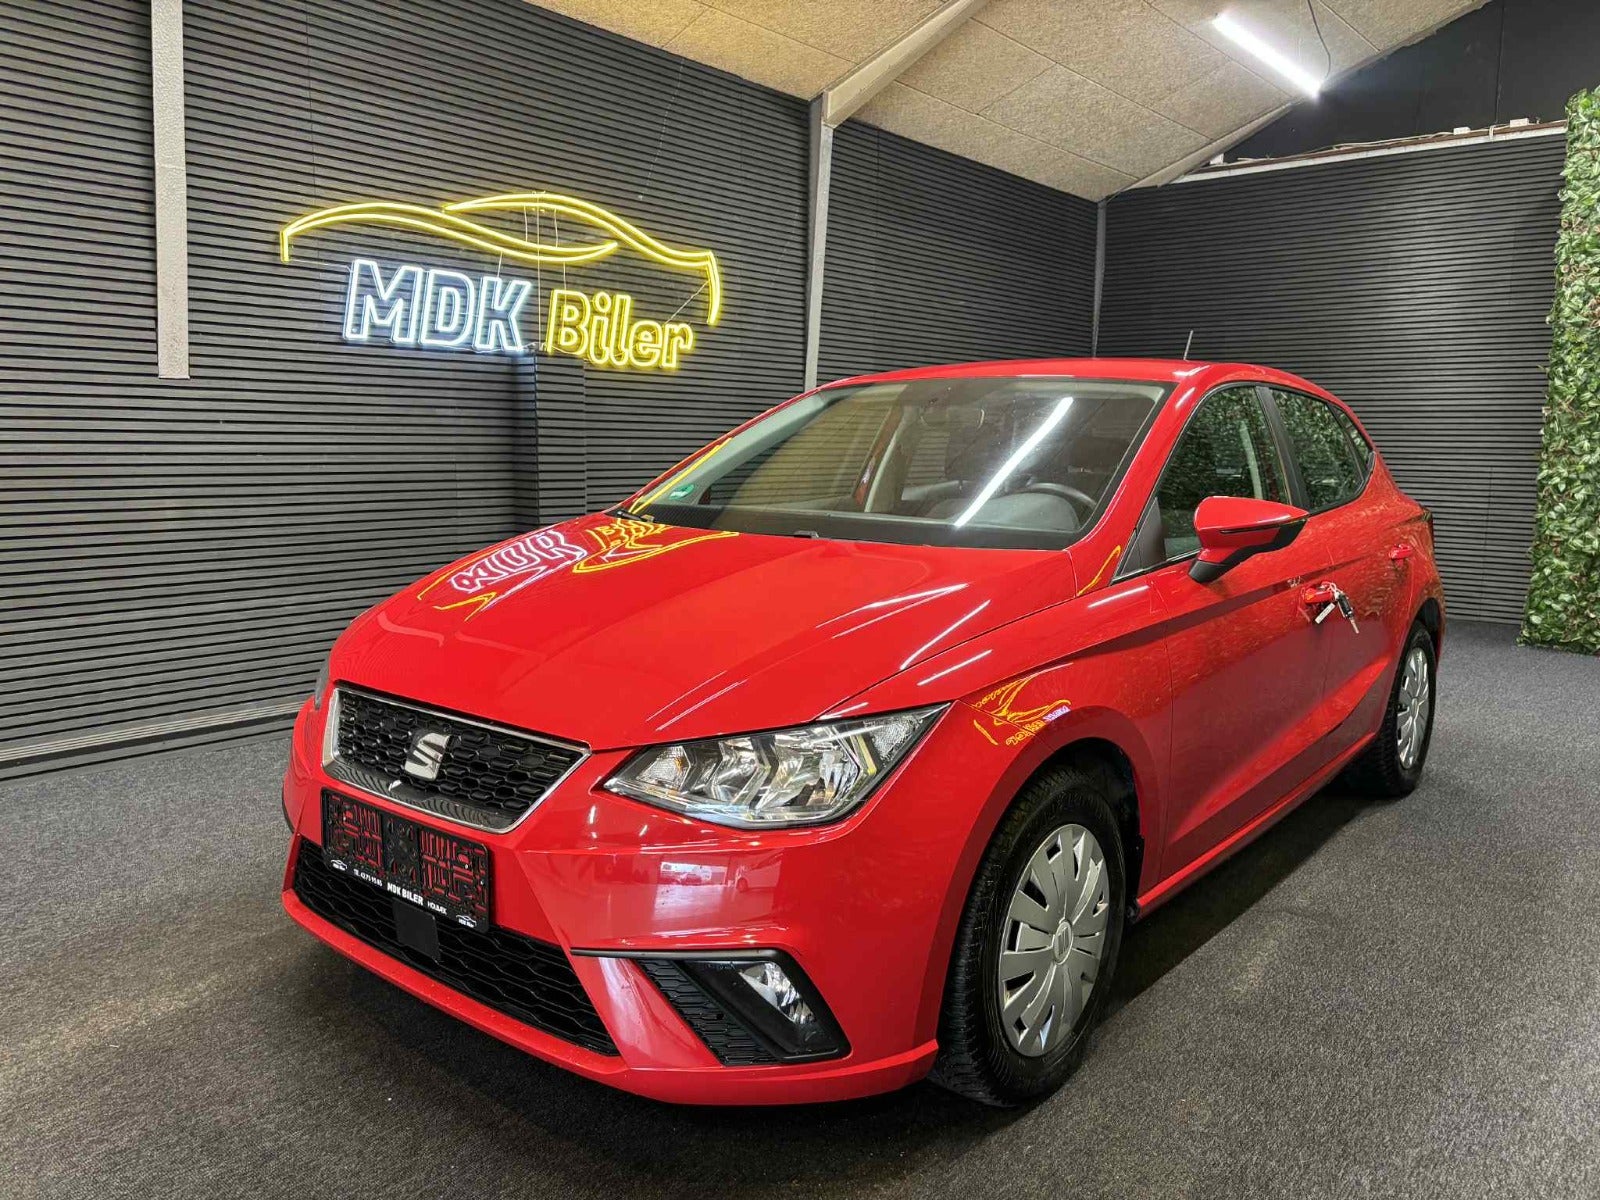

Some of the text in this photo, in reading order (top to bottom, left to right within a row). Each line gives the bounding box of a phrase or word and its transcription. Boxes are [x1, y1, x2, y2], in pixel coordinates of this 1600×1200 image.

[345, 258, 695, 370] MDK Biler
[386, 882, 401, 896] MDK
[401, 888, 424, 906] BILER
